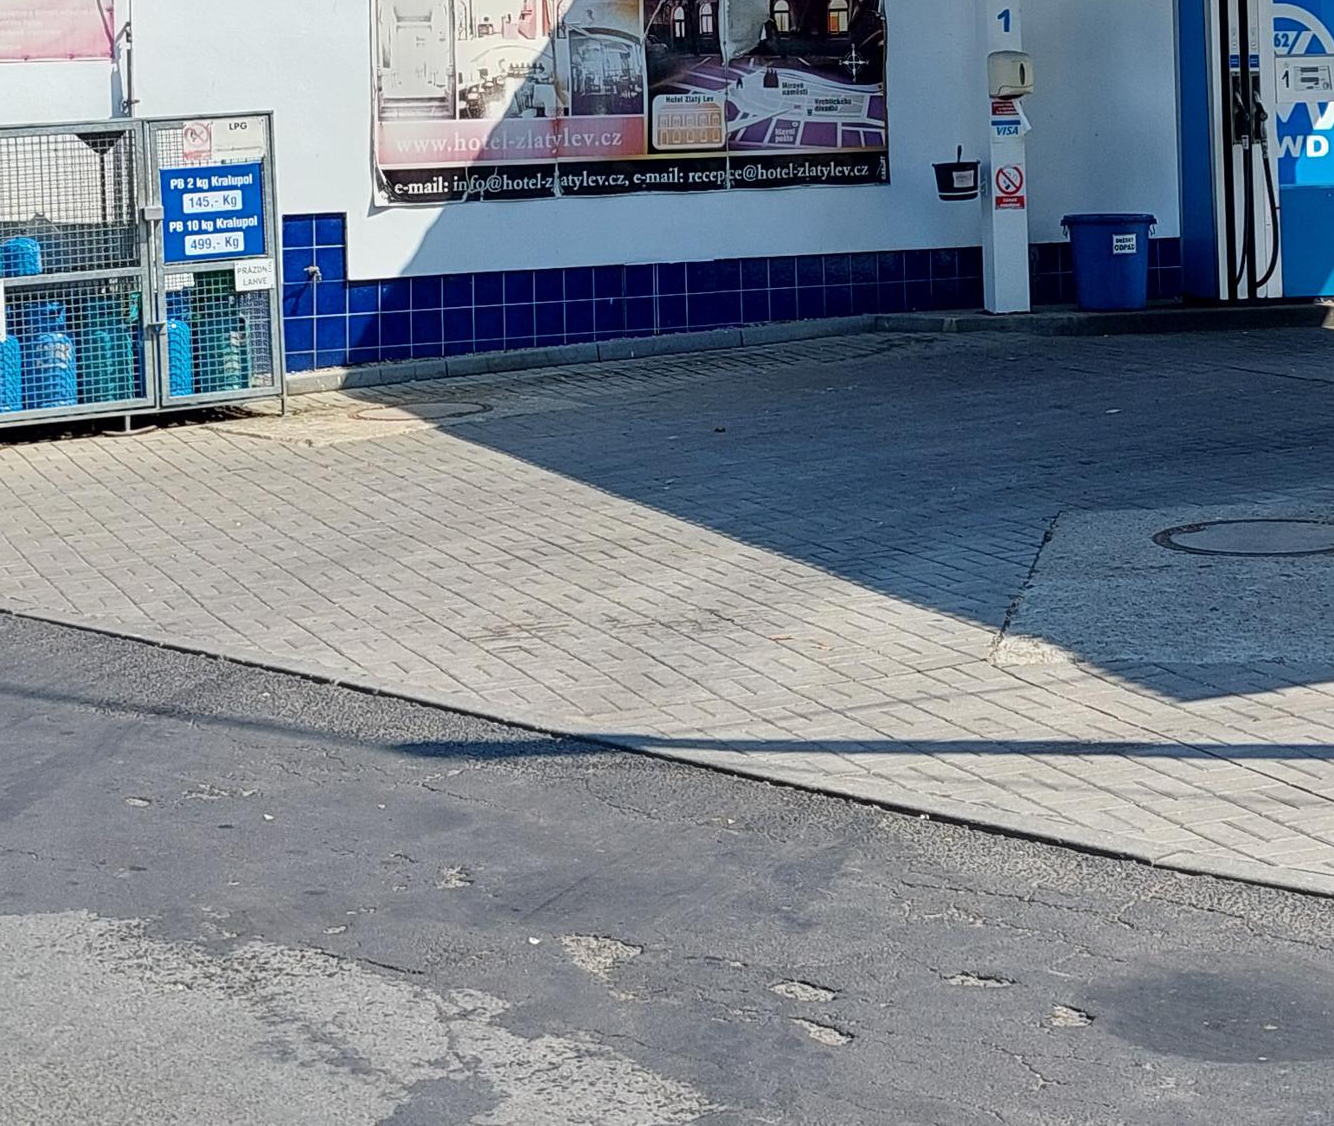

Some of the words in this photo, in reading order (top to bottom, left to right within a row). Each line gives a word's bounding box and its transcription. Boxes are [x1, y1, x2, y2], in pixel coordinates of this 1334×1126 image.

[997, 9, 1010, 32] 1
[1282, 70, 1289, 88] 1
[229, 122, 247, 131] LPG
[996, 126, 1019, 136] VISA
[395, 127, 624, 154] www.hotel-zlatylev.cz
[170, 178, 185, 190] PB
[187, 178, 194, 189] 2
[196, 177, 209, 190] kg
[211, 174, 253, 188] Kralupol
[394, 176, 450, 195] e-mail:
[633, 166, 684, 184] e-mail:
[169, 221, 184, 233] PB
[187, 220, 199, 231] 10
[201, 219, 214, 232] kg
[216, 216, 258, 230] Kralupol
